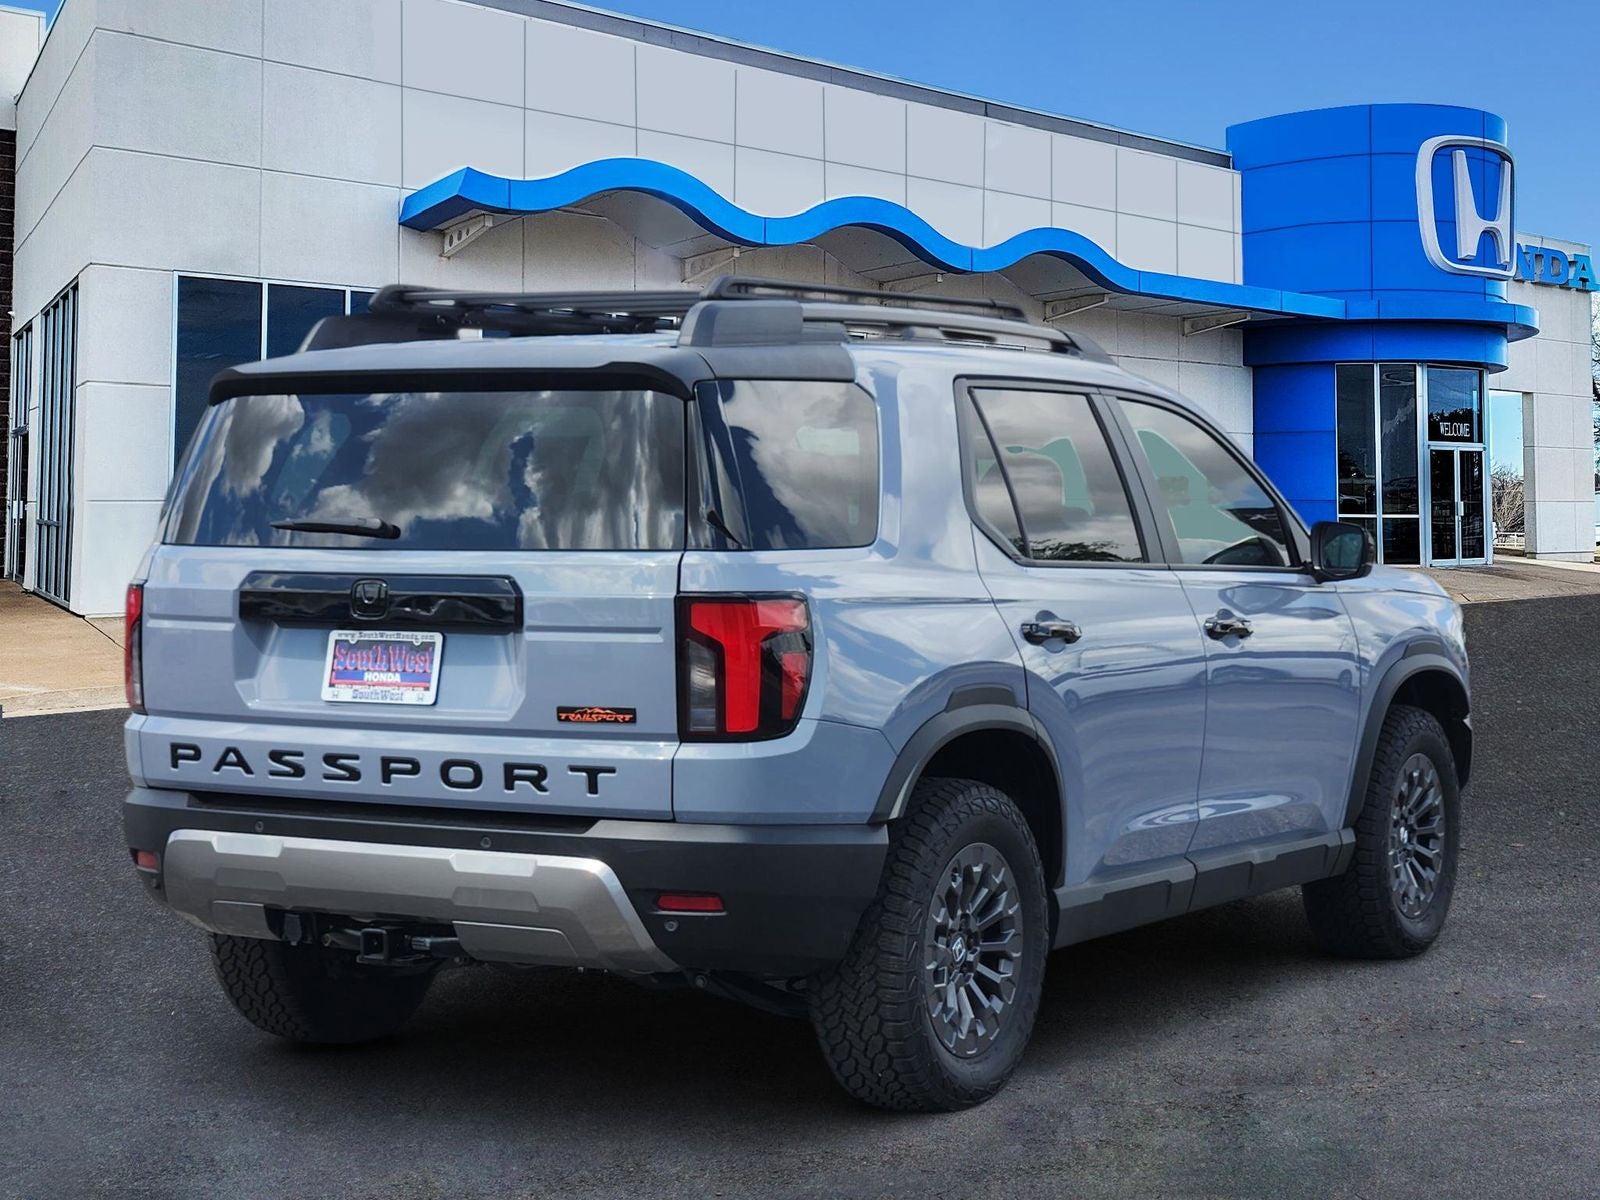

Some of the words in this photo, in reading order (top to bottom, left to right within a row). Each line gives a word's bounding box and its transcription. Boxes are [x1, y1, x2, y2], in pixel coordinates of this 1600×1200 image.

[1439, 421, 1471, 437] WELCOME
[363, 671, 402, 683] HONDA
[558, 712, 634, 723] TRAILSPORT
[169, 742, 618, 796] PASSPORT
